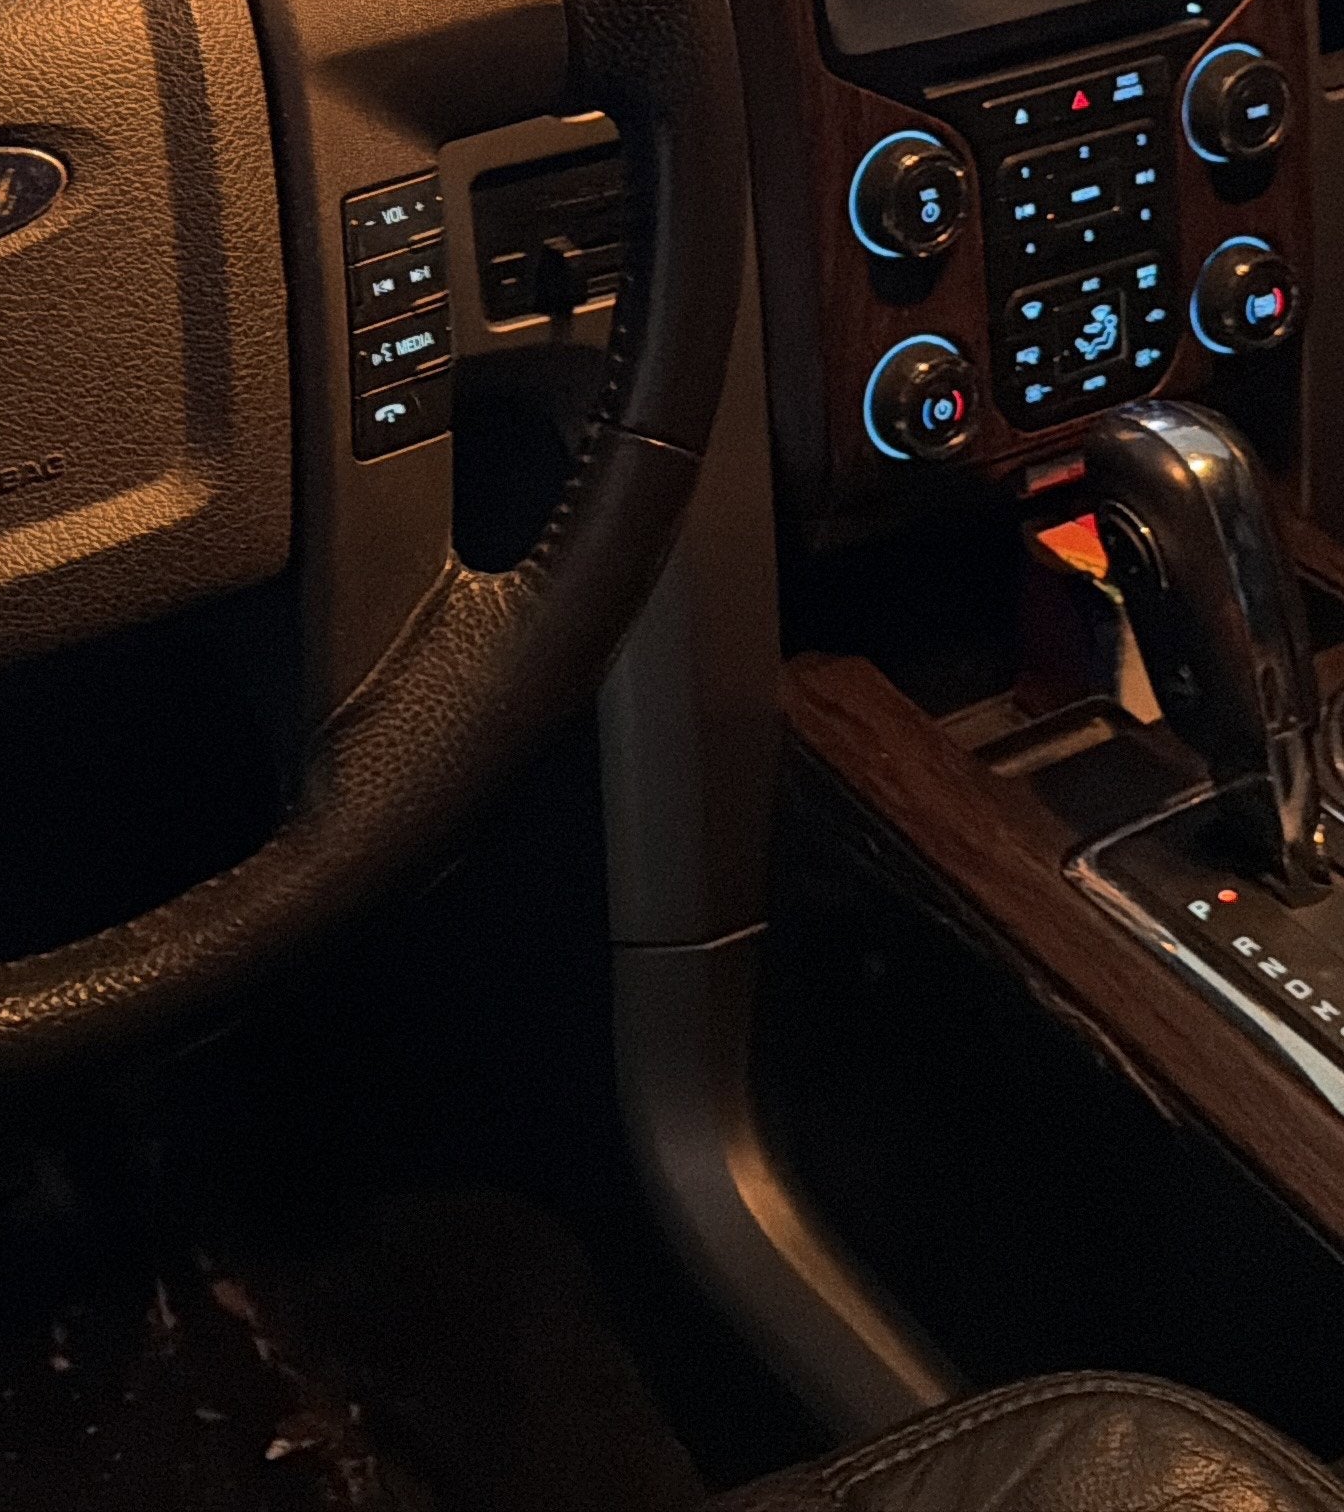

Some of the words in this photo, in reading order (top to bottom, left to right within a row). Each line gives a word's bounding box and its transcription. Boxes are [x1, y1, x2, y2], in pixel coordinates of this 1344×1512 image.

[381, 205, 409, 225] VOL
[395, 331, 435, 356] MEDIA
[1187, 899, 1212, 922] P
[1232, 936, 1262, 958] R
[1258, 956, 1288, 979] N
[1284, 979, 1313, 1001] D
[1311, 1000, 1341, 1022] M
